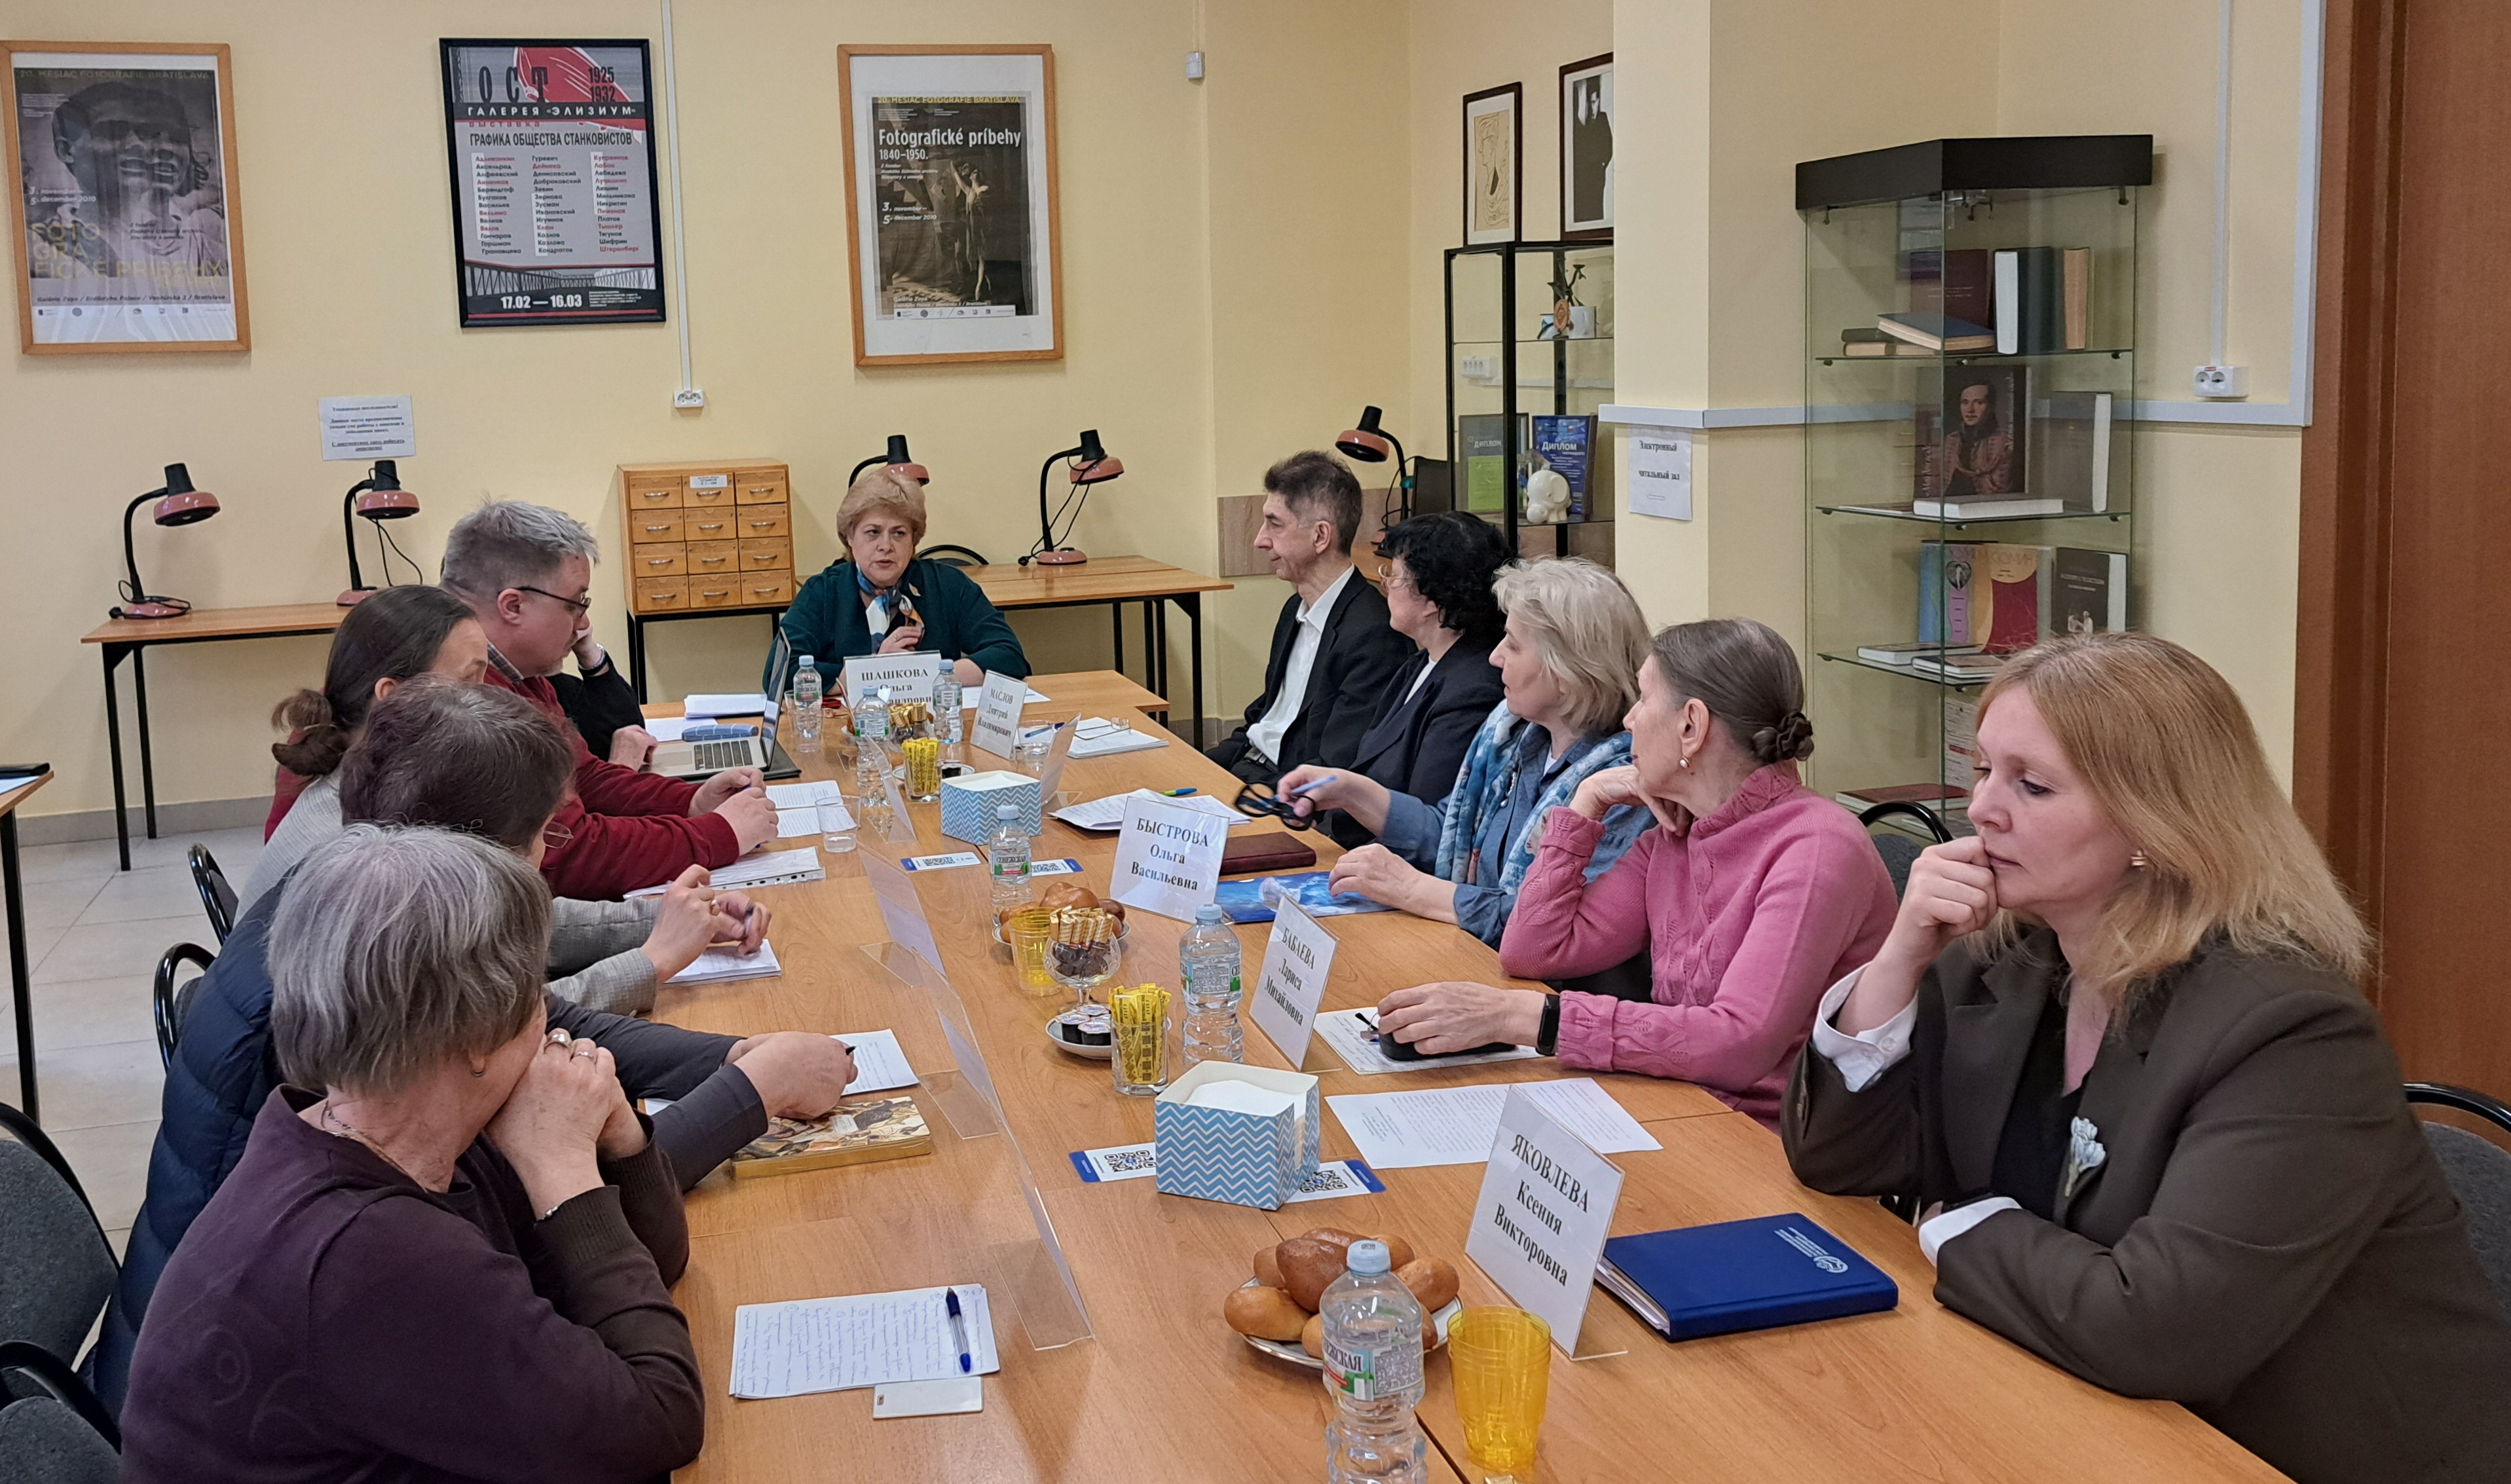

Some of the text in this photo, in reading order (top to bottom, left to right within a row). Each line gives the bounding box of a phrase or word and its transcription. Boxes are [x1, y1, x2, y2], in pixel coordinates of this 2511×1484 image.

[479, 66, 549, 103] ОСТ
[587, 67, 615, 83] 1925
[589, 86, 616, 102] 1932
[468, 106, 636, 116] ГАЛЕРЕЯ «ЭЛИЗИУМ»
[470, 132, 632, 148] ГРАФИКА ОБЩЕСТВА СТАНКОВИСТОВ
[879, 127, 1022, 147] Fotografické príbehy
[30, 223, 100, 241] FOTO
[500, 295, 531, 308] 17.02
[550, 294, 582, 308] 16.03
[1542, 441, 1577, 452] Диплом
[861, 668, 929, 681] ШАШКОВА
[989, 688, 1014, 704] МАСЛОВ
[1136, 817, 1208, 847] БЫСТРОВА
[1150, 844, 1185, 864] Ольга
[1131, 861, 1198, 891] Васильевна
[1282, 926, 1316, 970] БАБАЕВА
[1278, 957, 1302, 992] Лариса
[1264, 974, 1304, 1027] Михайловна
[1510, 1134, 1589, 1214] ЯКОВЛЕВА
[1516, 1179, 1563, 1236] Ксения
[1493, 1202, 1568, 1287] Викторовна
